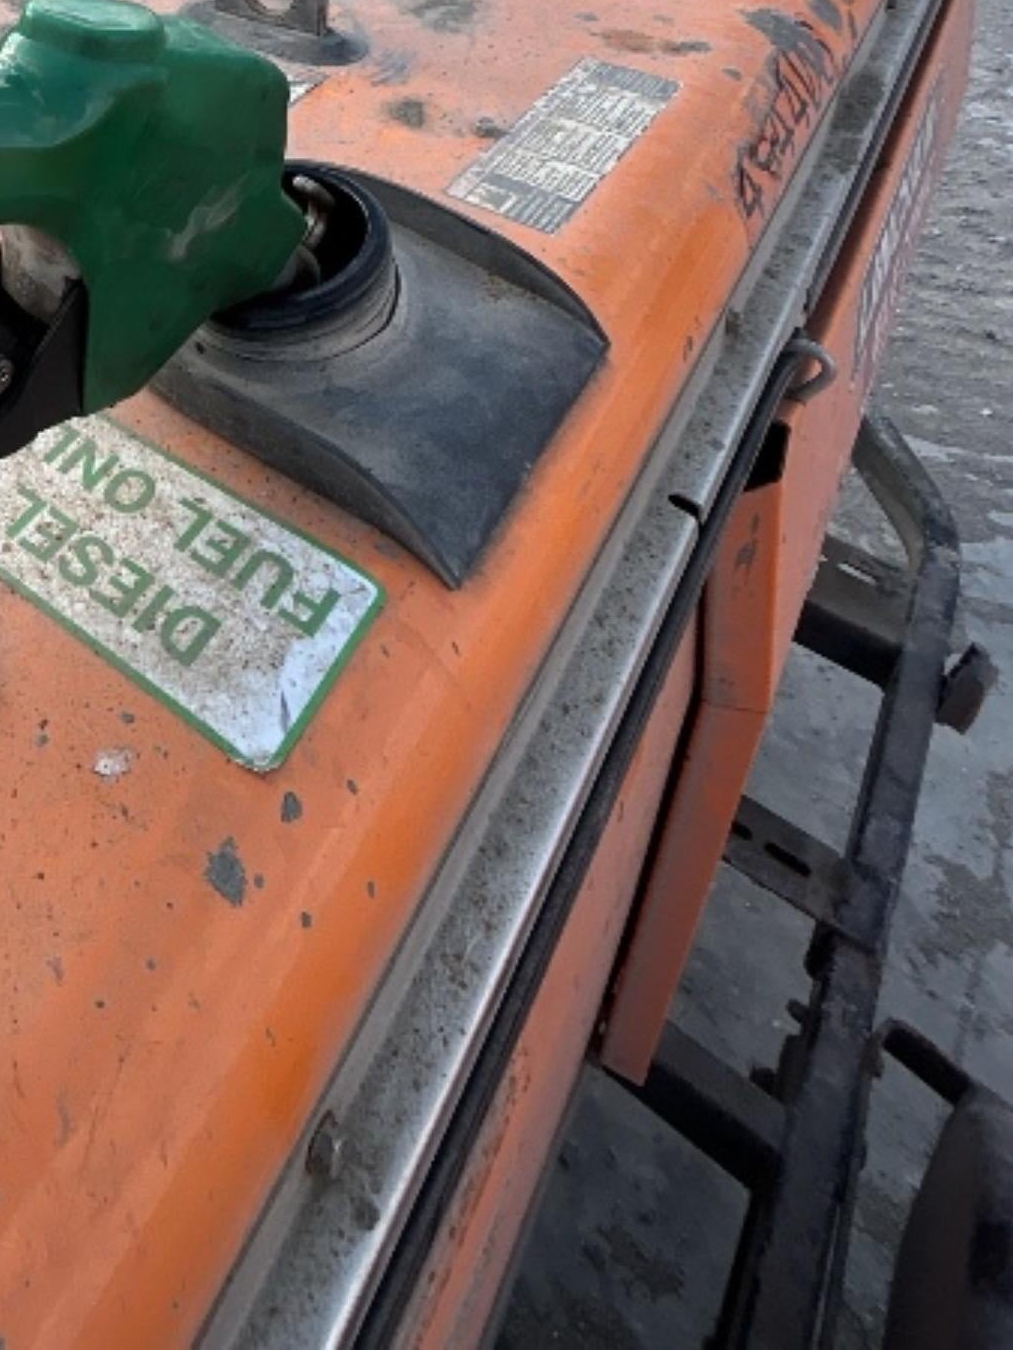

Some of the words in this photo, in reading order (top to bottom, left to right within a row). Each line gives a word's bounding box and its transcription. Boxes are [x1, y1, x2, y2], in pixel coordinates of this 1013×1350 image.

[44, 423, 156, 513] ONL
[5, 483, 222, 667] DIESEL
[174, 497, 341, 638] FUEL
